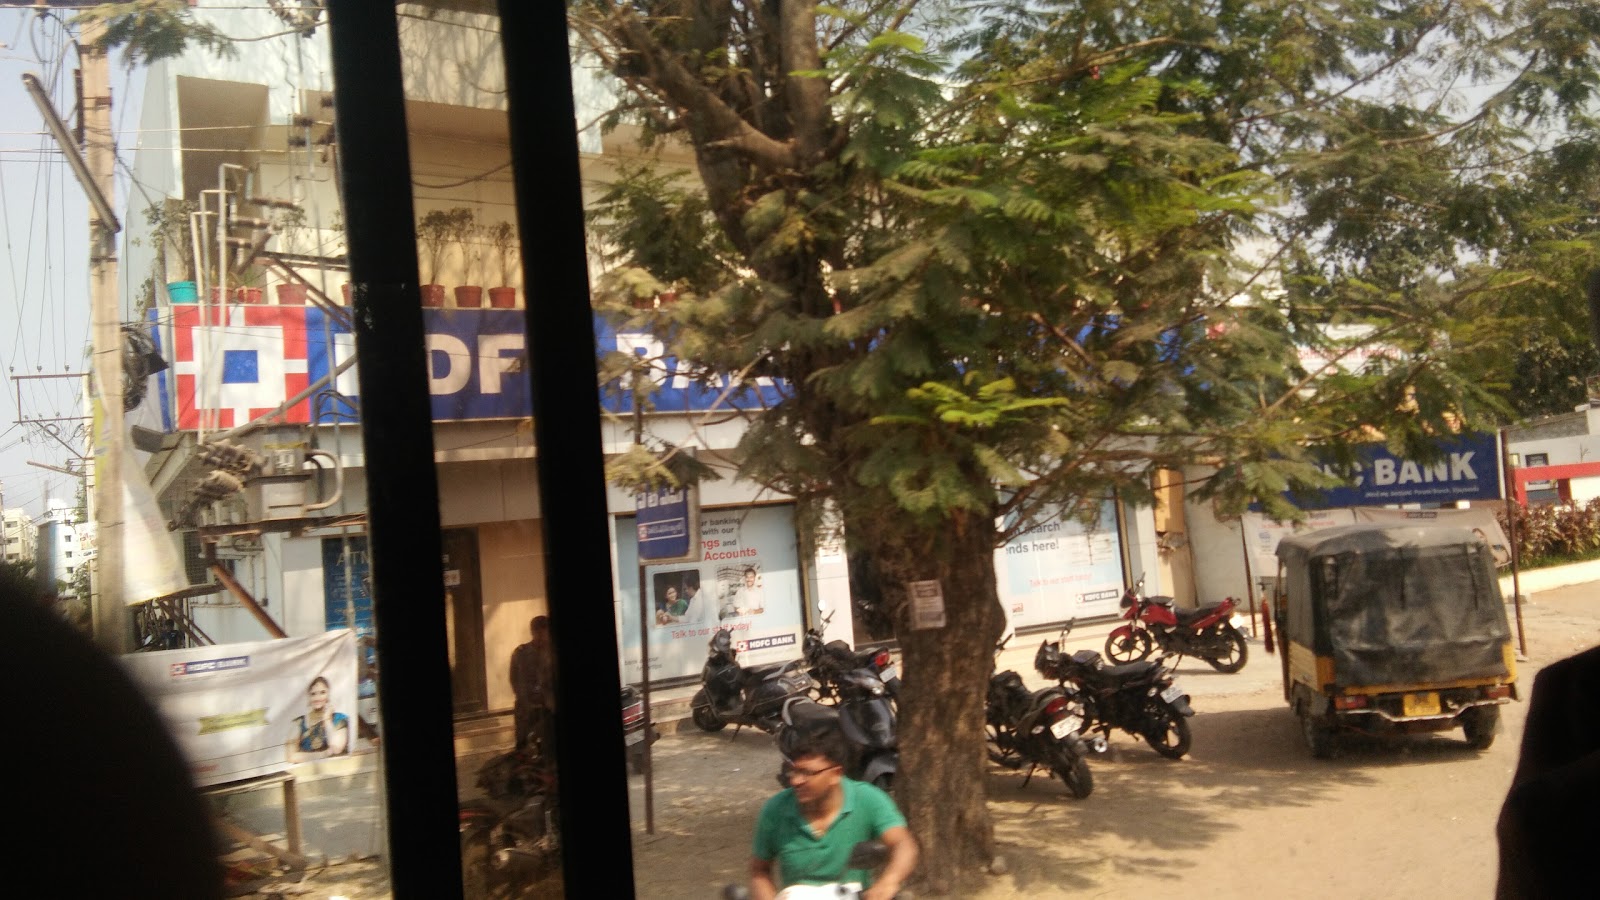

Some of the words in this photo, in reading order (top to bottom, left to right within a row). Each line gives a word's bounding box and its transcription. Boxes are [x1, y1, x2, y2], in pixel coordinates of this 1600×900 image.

[1374, 451, 1478, 486] BANK
[722, 539, 737, 547] and
[1032, 537, 1060, 552] here!
[704, 547, 757, 561] Accounts
[672, 630, 686, 639] Talk
[698, 628, 710, 636] our
[749, 639, 771, 649] HDFC
[771, 635, 794, 646] BANK
